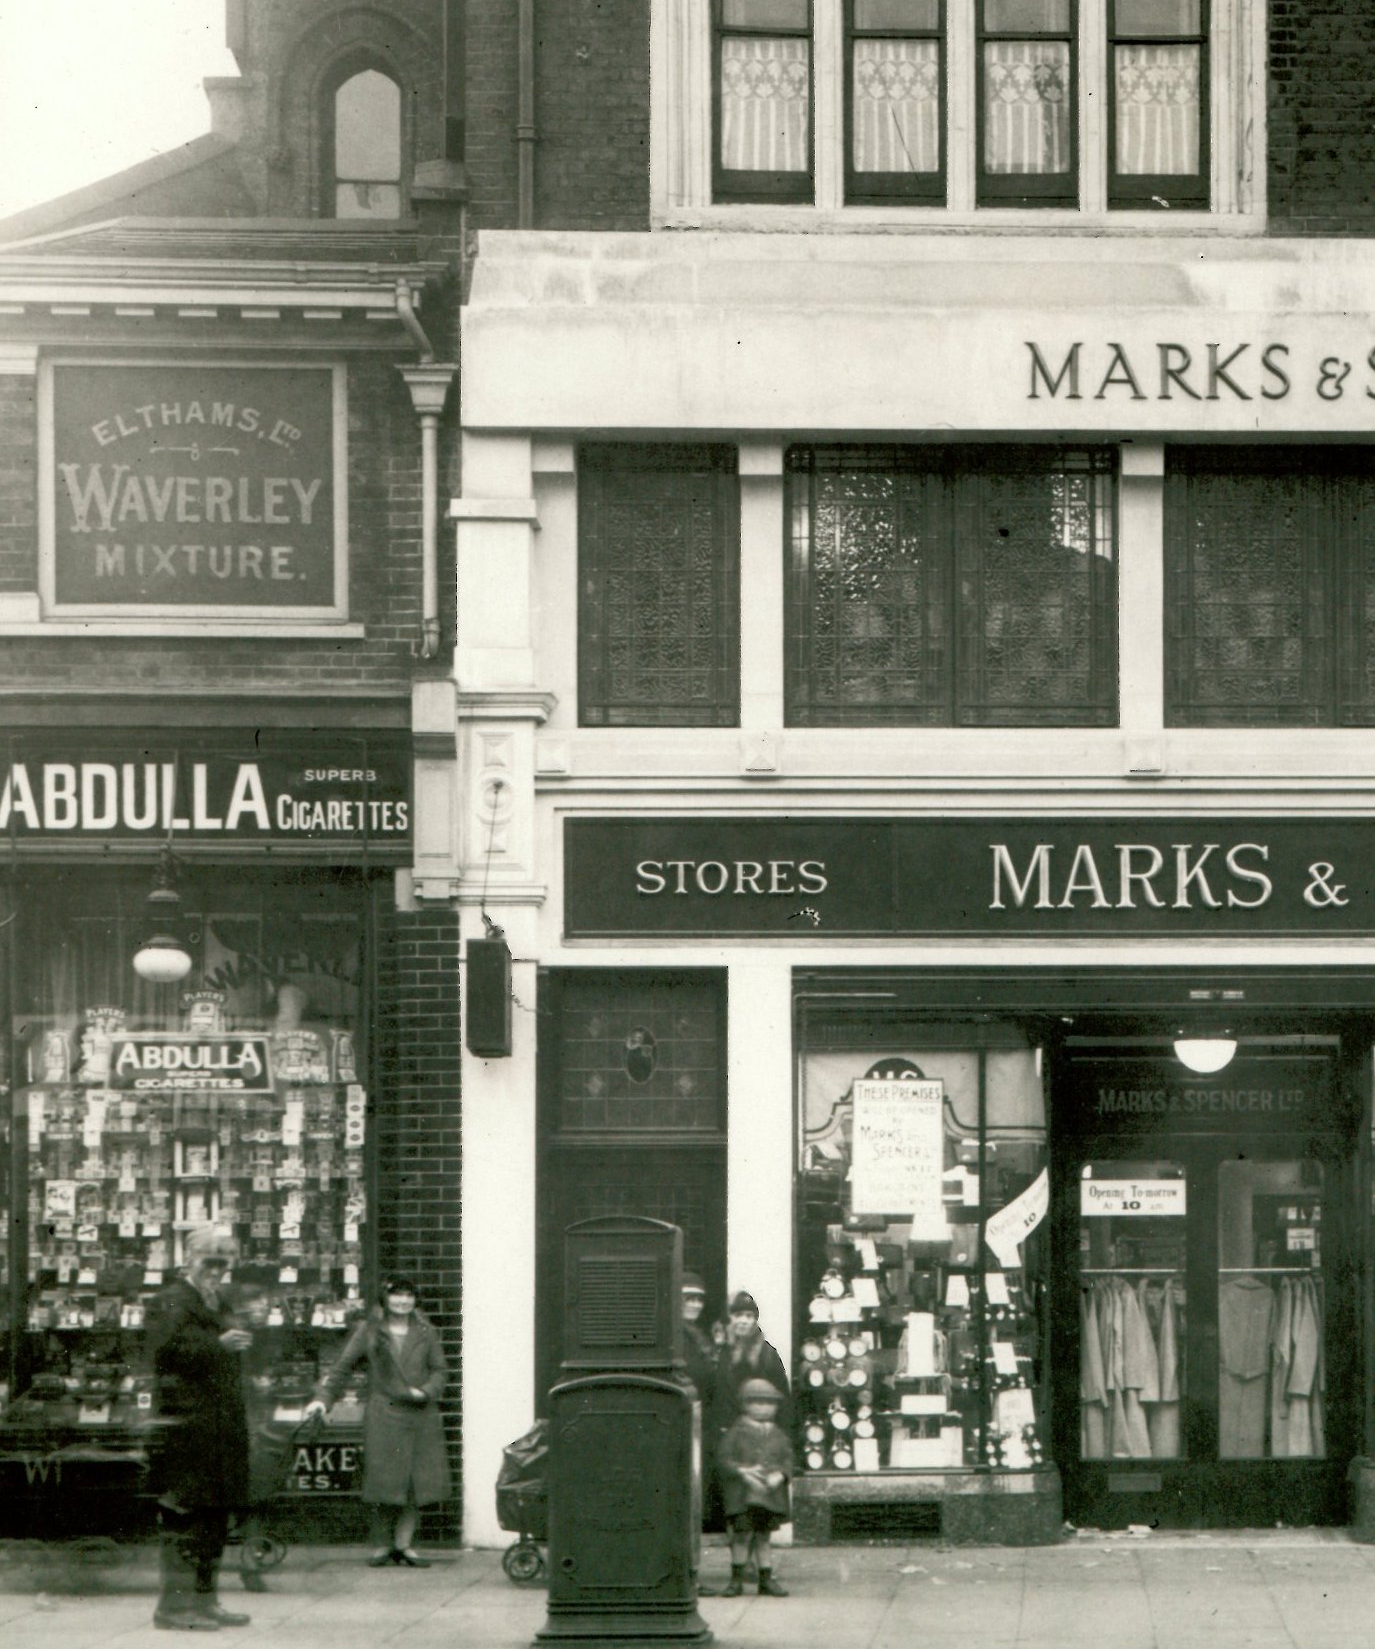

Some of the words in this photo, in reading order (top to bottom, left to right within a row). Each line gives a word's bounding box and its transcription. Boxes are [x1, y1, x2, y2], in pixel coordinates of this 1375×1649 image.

[1024, 341, 1290, 401] MARKS
[1316, 356, 1352, 401] &
[58, 462, 322, 533] WAVERLEY
[304, 769, 377, 782] SUPERB
[0, 763, 271, 831] ABDULLA
[277, 794, 408, 830] CIGARETTES
[636, 861, 828, 895] STORES
[989, 843, 1273, 908] MARKS
[1303, 861, 1350, 907] &
[116, 1042, 262, 1077] ABDULLA
[134, 1078, 245, 1089] CIGARETTES
[857, 1083, 889, 1100] THESE
[891, 1083, 941, 1100] PREMISES
[1100, 1089, 1167, 1112] MARKS
[1183, 1089, 1272, 1112] SPENCER
[1089, 1184, 1125, 1200] Opening
[1121, 1200, 1142, 1210] 10
[1023, 1212, 1037, 1228] 10
